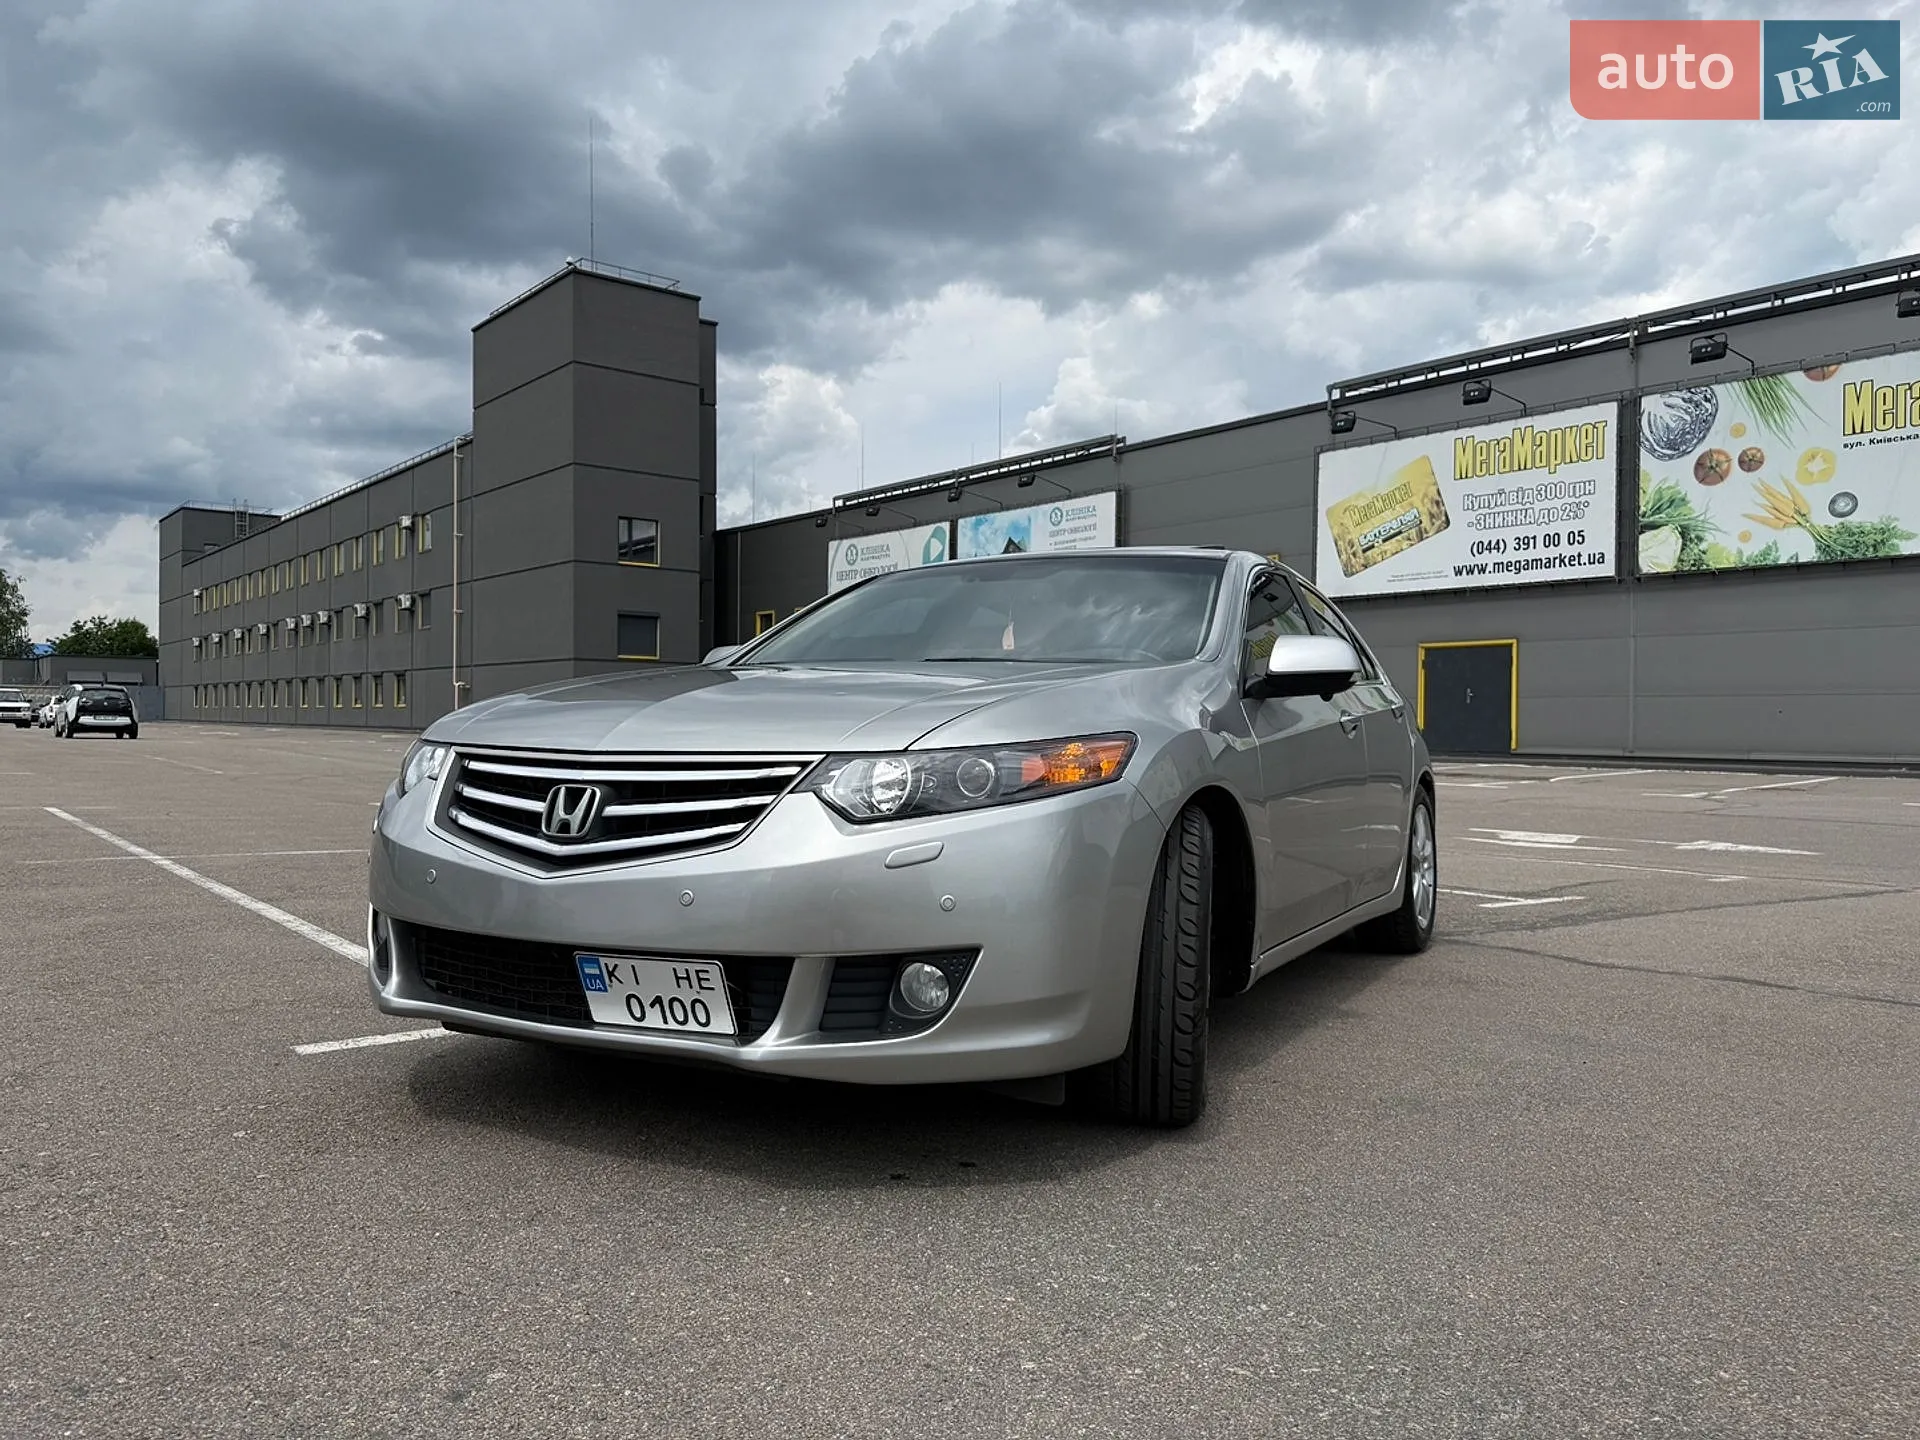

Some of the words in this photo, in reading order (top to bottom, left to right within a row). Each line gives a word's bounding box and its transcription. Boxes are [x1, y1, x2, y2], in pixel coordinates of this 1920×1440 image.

[1453, 420, 1608, 481] МегаМаркет
[1463, 489, 1506, 511] Купуй
[1508, 487, 1534, 506] від
[1536, 481, 1566, 500] 300
[1568, 479, 1596, 499] грн
[1475, 507, 1535, 531] ЗНИЖКА
[1536, 507, 1559, 526] до
[1470, 539, 1507, 557] (044)
[1514, 535, 1537, 551] 391
[1543, 532, 1561, 549] 00
[1567, 530, 1585, 546] 05
[1453, 551, 1606, 577] www.megamarket.ua
[586, 979, 605, 991] UA
[625, 993, 711, 1028] 0100
